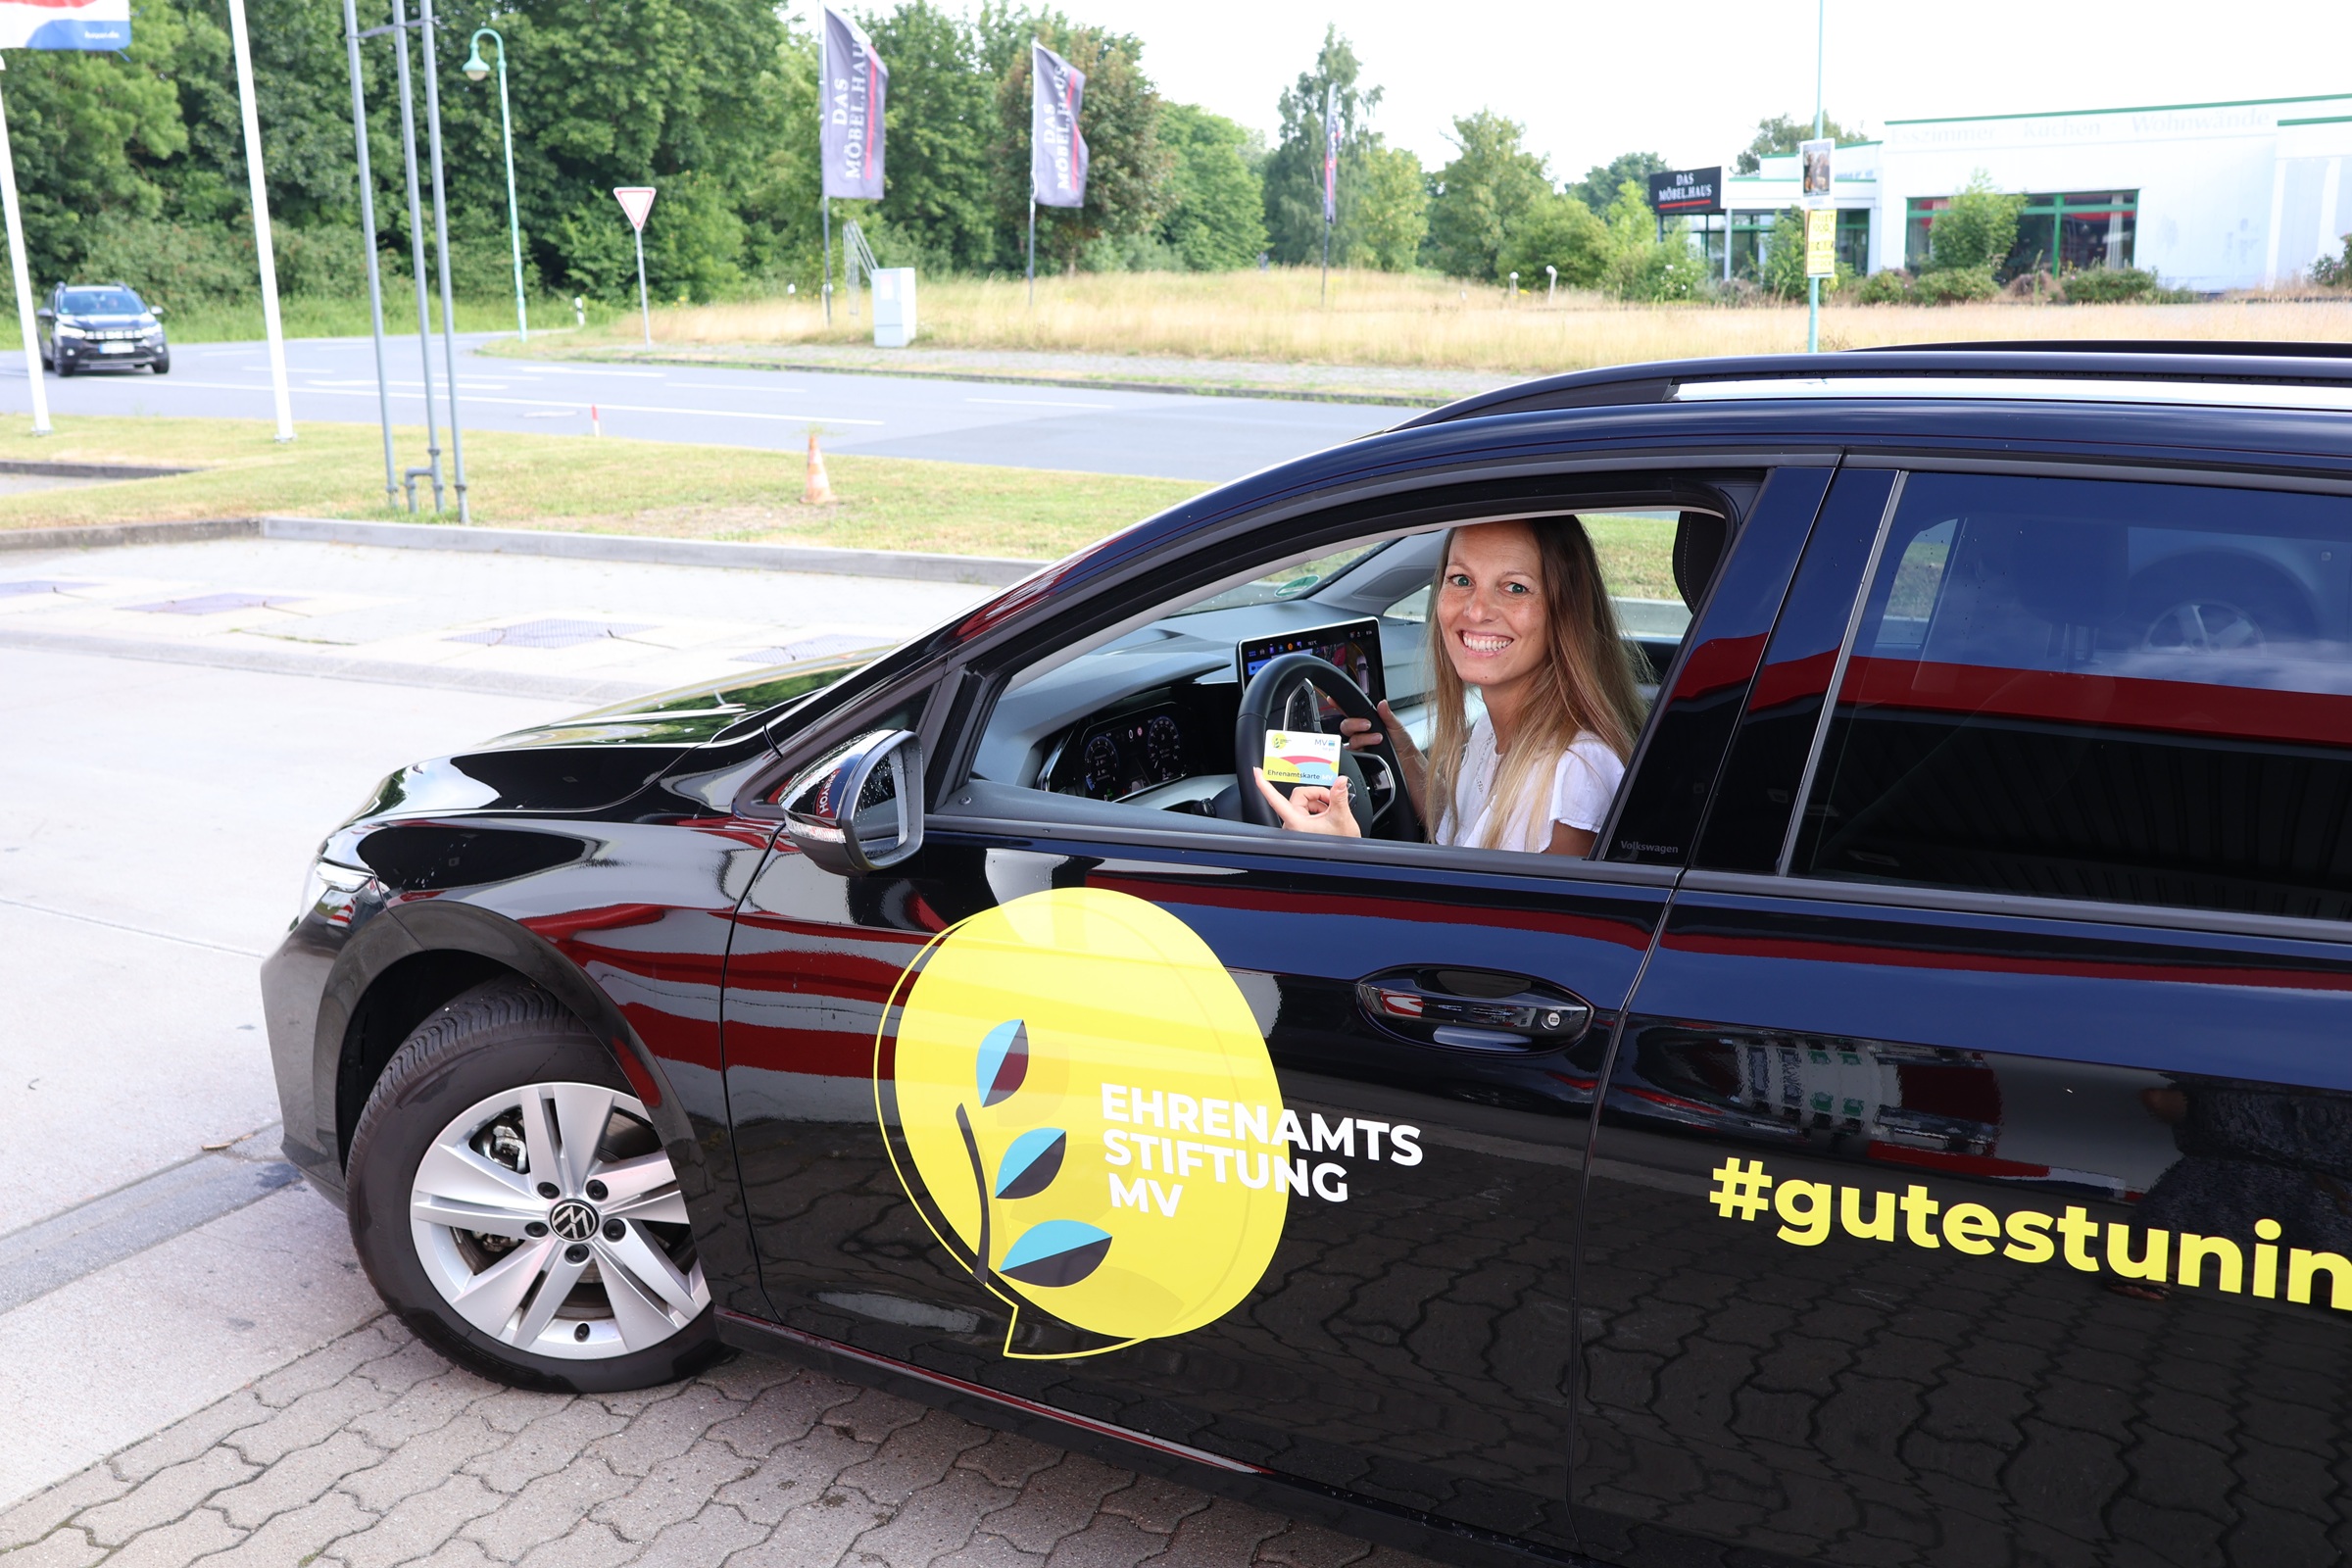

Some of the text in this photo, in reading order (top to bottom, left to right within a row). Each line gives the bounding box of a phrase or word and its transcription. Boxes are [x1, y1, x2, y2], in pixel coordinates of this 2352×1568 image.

[832, 77, 849, 125] DAS
[2131, 107, 2270, 133] Wohnwände
[1043, 103, 1056, 144] DAS
[1676, 172, 1694, 186] DAS
[1267, 769, 1321, 780] Ehrenamtskarte
[1620, 840, 1679, 855] Volkswagen
[1101, 1082, 1424, 1167] EHRENAMTS
[1102, 1128, 1348, 1202] STIFTUNG
[1108, 1173, 1183, 1218] MV
[1709, 1156, 2352, 1311] #gutestunin
